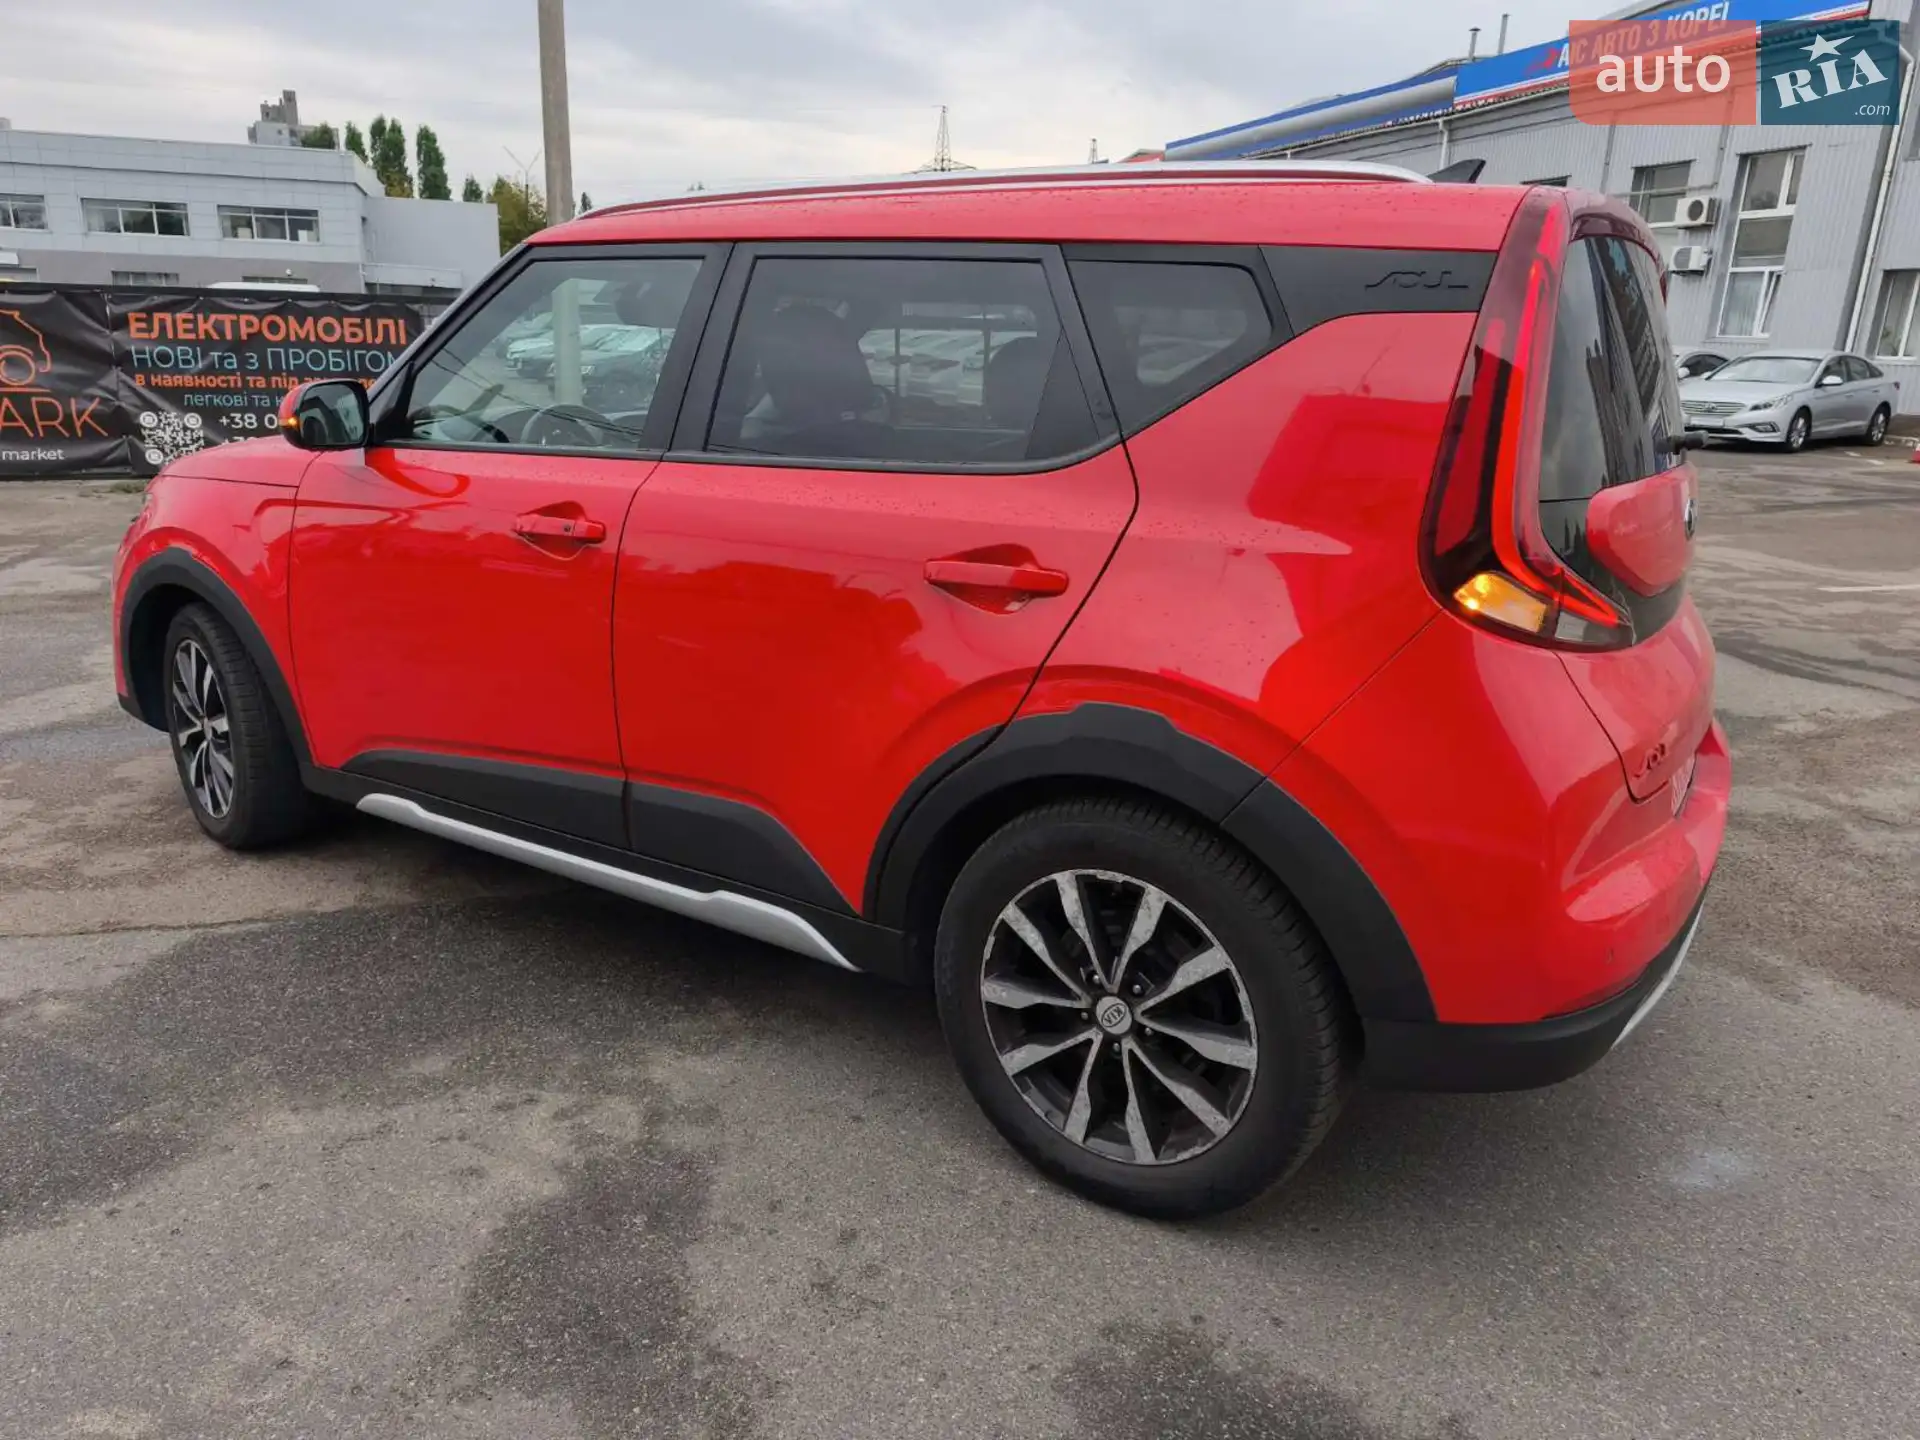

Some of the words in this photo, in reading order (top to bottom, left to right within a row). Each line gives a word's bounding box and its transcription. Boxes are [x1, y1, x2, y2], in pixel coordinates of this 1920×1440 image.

[127, 311, 408, 345] ЕЛЕКТРОМОБІЛІ
[131, 345, 202, 370] НОВІ
[209, 351, 238, 370] та
[245, 351, 259, 370] з
[135, 374, 146, 387] в
[151, 371, 242, 388] наявності
[247, 375, 267, 388] та
[184, 390, 249, 406] легкові
[251, 393, 270, 406] та
[220, 412, 258, 429] +38
[1, 447, 67, 460] market
[1103, 1005, 1124, 1025] KIA
